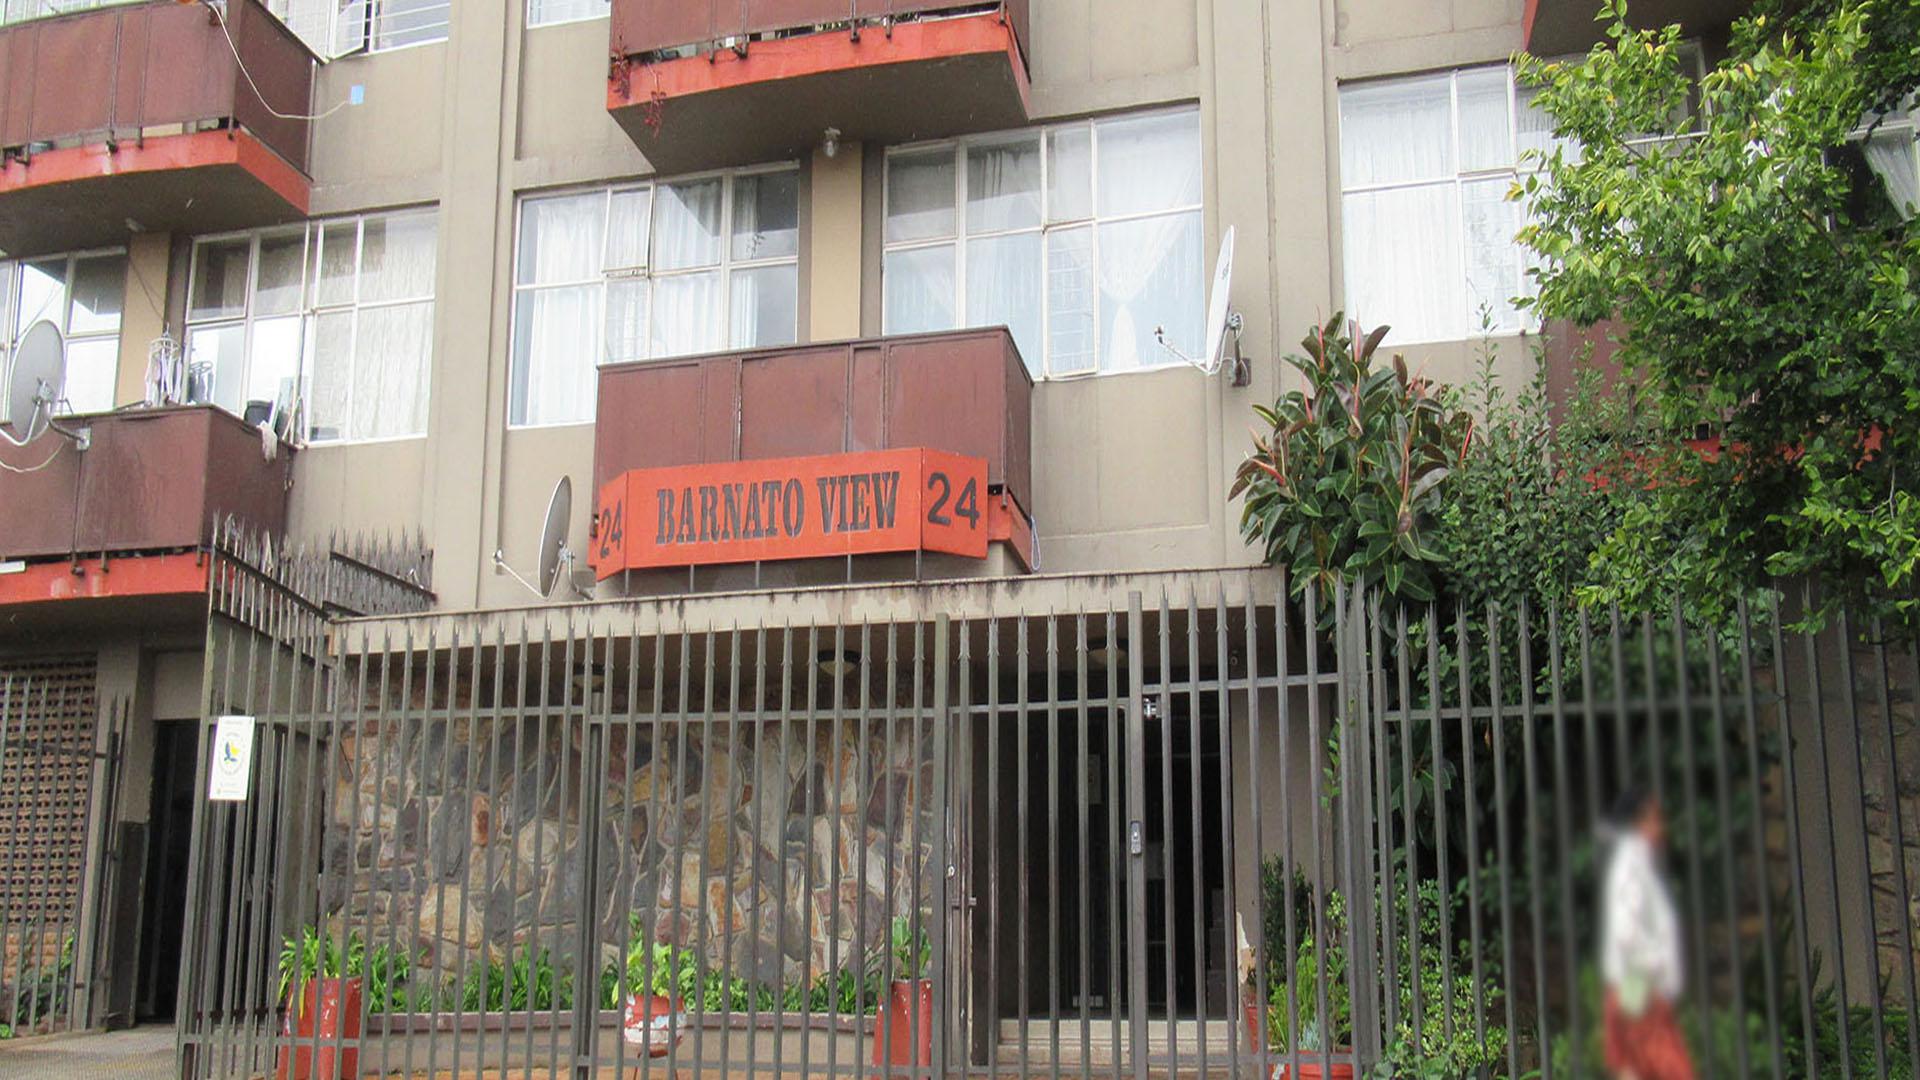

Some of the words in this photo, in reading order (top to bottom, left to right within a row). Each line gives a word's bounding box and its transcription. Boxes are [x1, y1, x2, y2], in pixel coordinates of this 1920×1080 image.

[600, 498, 622, 559] 24
[656, 478, 804, 545] BARNATO
[816, 471, 900, 534] VIEW
[927, 472, 980, 530] 24
